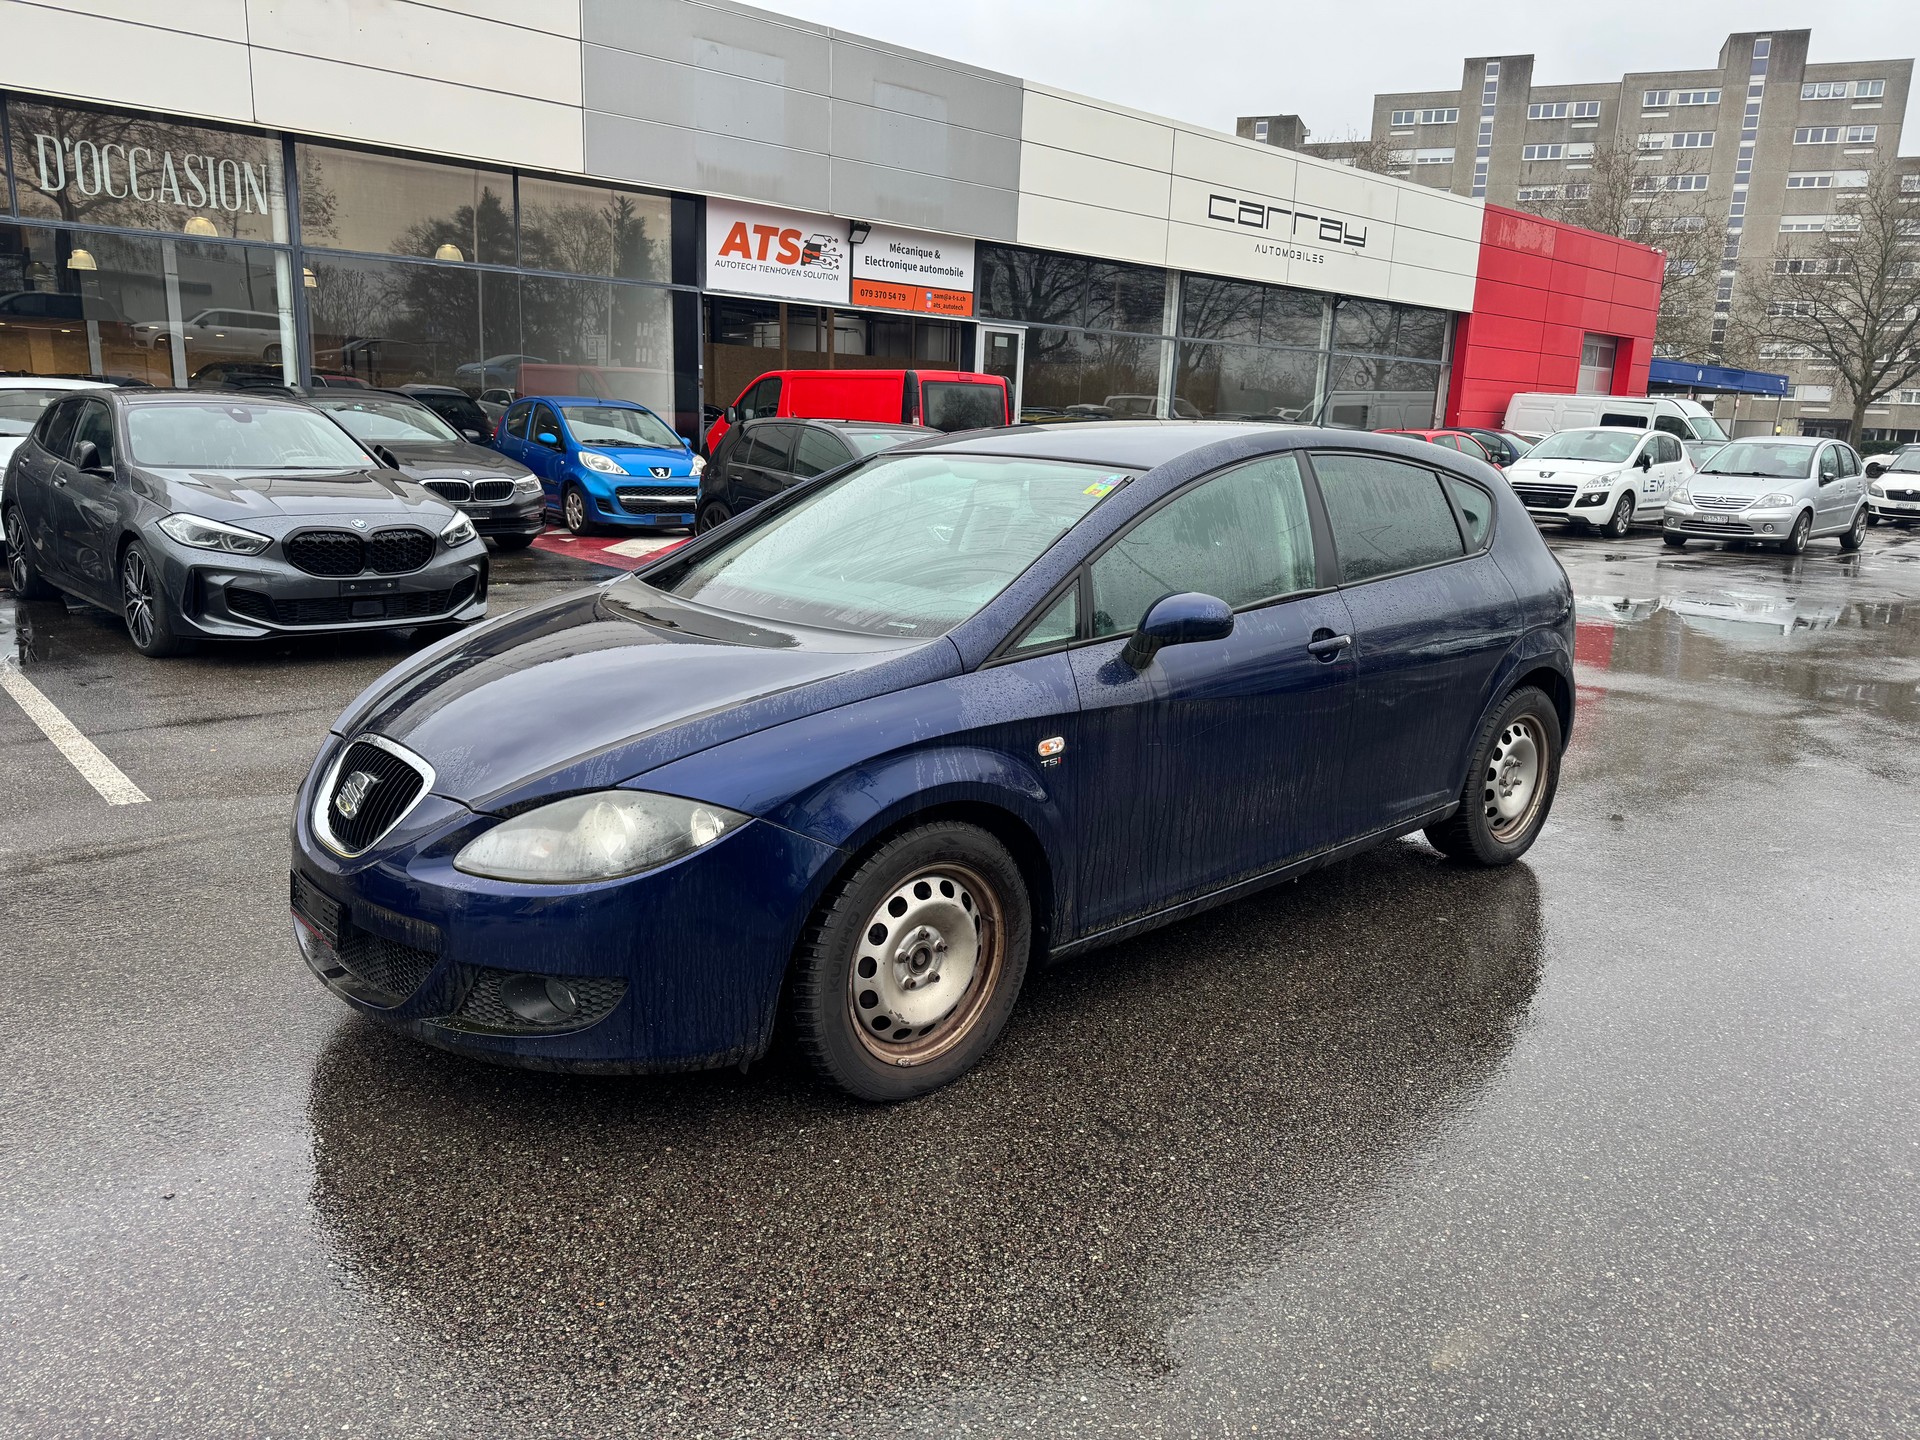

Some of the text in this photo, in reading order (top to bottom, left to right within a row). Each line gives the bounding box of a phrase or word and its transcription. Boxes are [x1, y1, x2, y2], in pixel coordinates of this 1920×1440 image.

[34, 133, 268, 215] D'OCCASION
[718, 221, 803, 265] ATS
[889, 242, 941, 260] Mécanique &
[1254, 243, 1325, 264] AUTOMOBILES
[714, 259, 839, 281] AUTOTECH TIENHOVEN SOLUTION
[864, 255, 964, 278] Electronique automobile
[860, 288, 907, 302] 079 370 54 79
[1643, 480, 1665, 493] LEM
[828, 911, 861, 994] KUMHO
